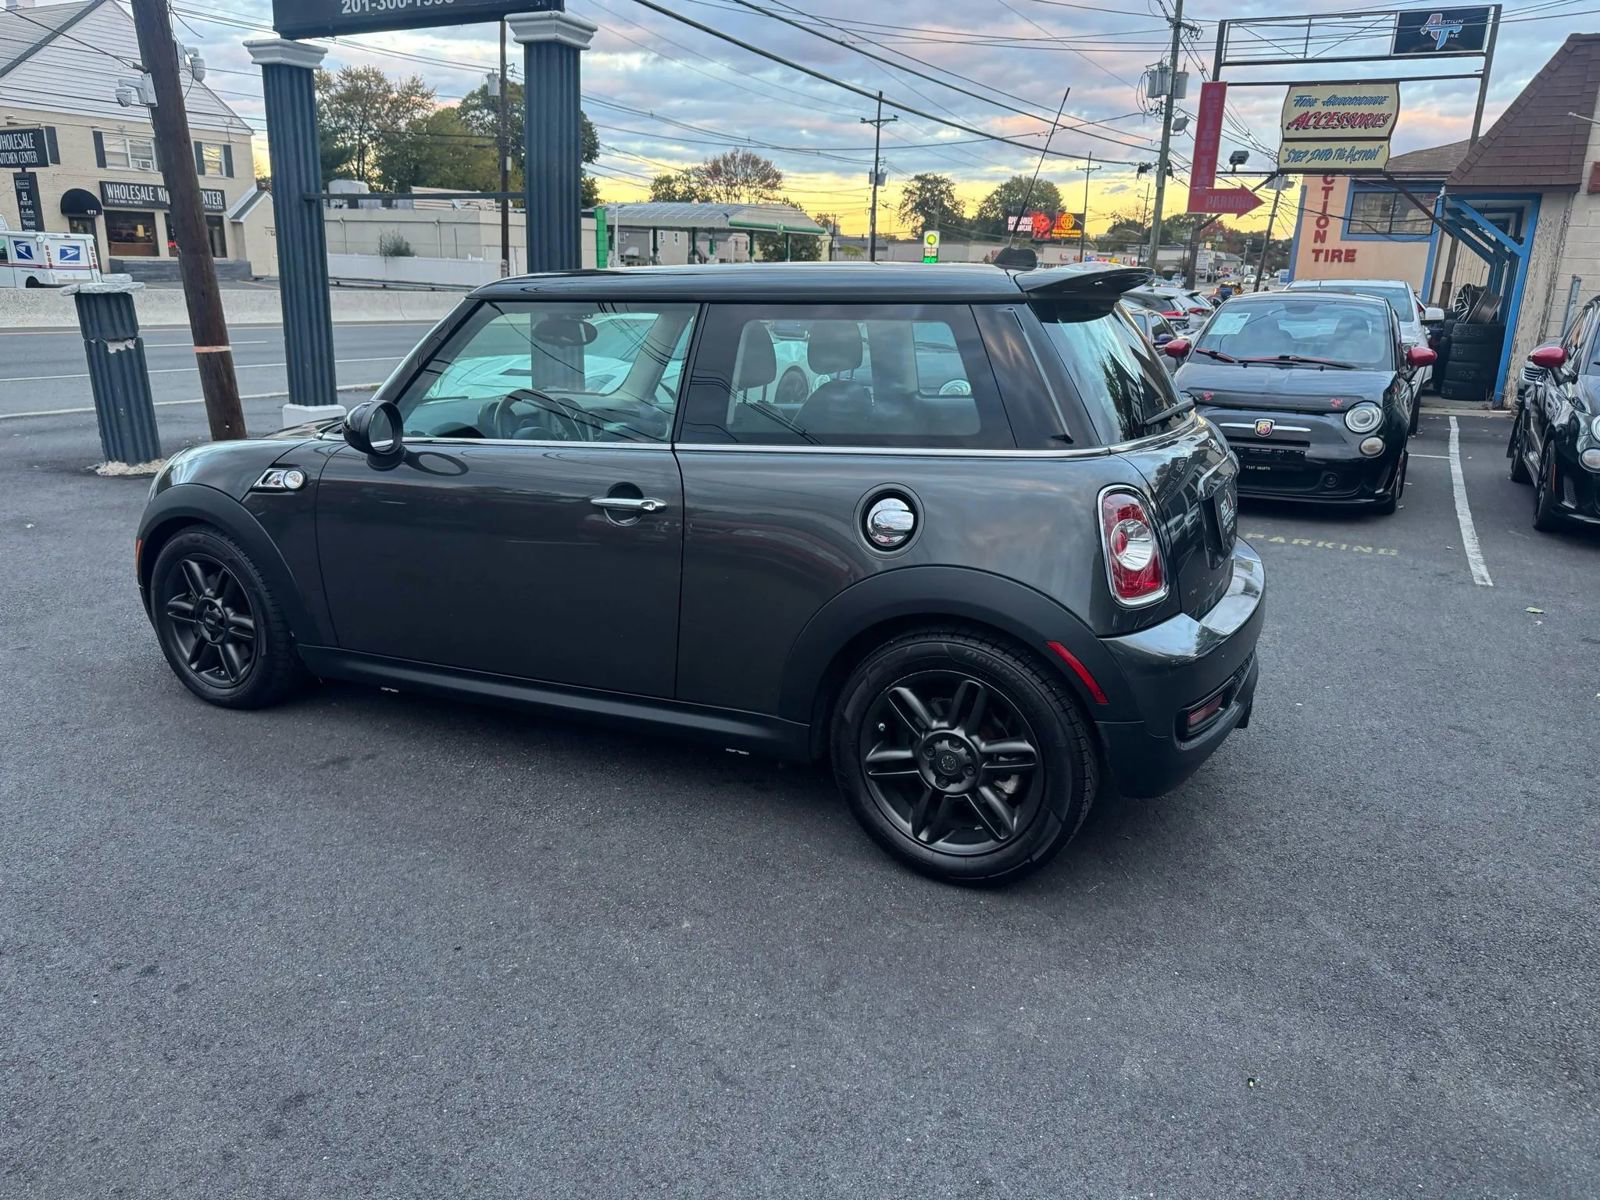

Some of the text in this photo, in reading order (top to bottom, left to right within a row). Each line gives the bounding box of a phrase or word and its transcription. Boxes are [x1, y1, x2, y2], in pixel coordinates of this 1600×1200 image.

[341, 0, 455, 14] 201-300-
[1286, 111, 1392, 130] ACCESSORIES
[19, 151, 38, 164] CENTER
[105, 183, 155, 201] WHOLESALE
[202, 190, 223, 205] NTER
[1313, 175, 1336, 244] CTION
[1312, 249, 1357, 263] TIRE
